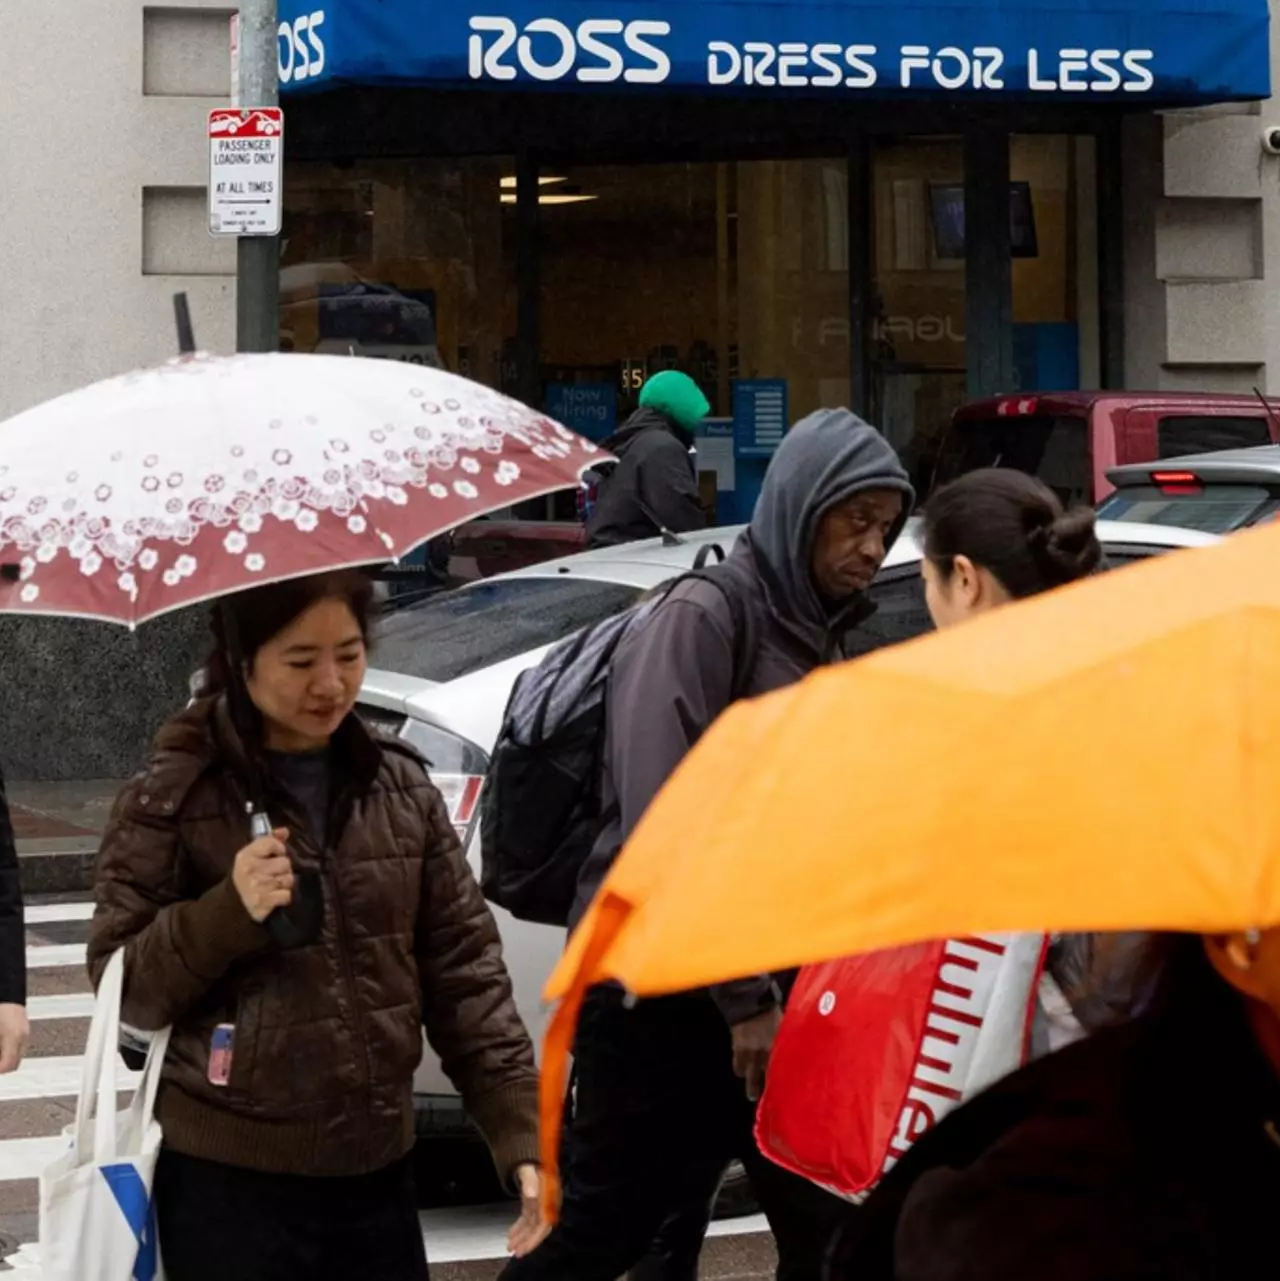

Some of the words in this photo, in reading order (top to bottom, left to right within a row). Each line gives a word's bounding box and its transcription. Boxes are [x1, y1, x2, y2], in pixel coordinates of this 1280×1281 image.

[277, 10, 324, 83] OSS
[468, 15, 671, 83] ROSS
[707, 41, 877, 89] DRESS
[900, 45, 1004, 89] FOR
[1028, 48, 1154, 92] LESS
[214, 153, 252, 166] LOADING
[253, 152, 276, 165] ONLY
[218, 139, 272, 151] PASSENGER
[216, 182, 226, 193] AT
[229, 182, 245, 193] ALL
[248, 181, 274, 194] TIMES
[884, 931, 1006, 1158] lulule
